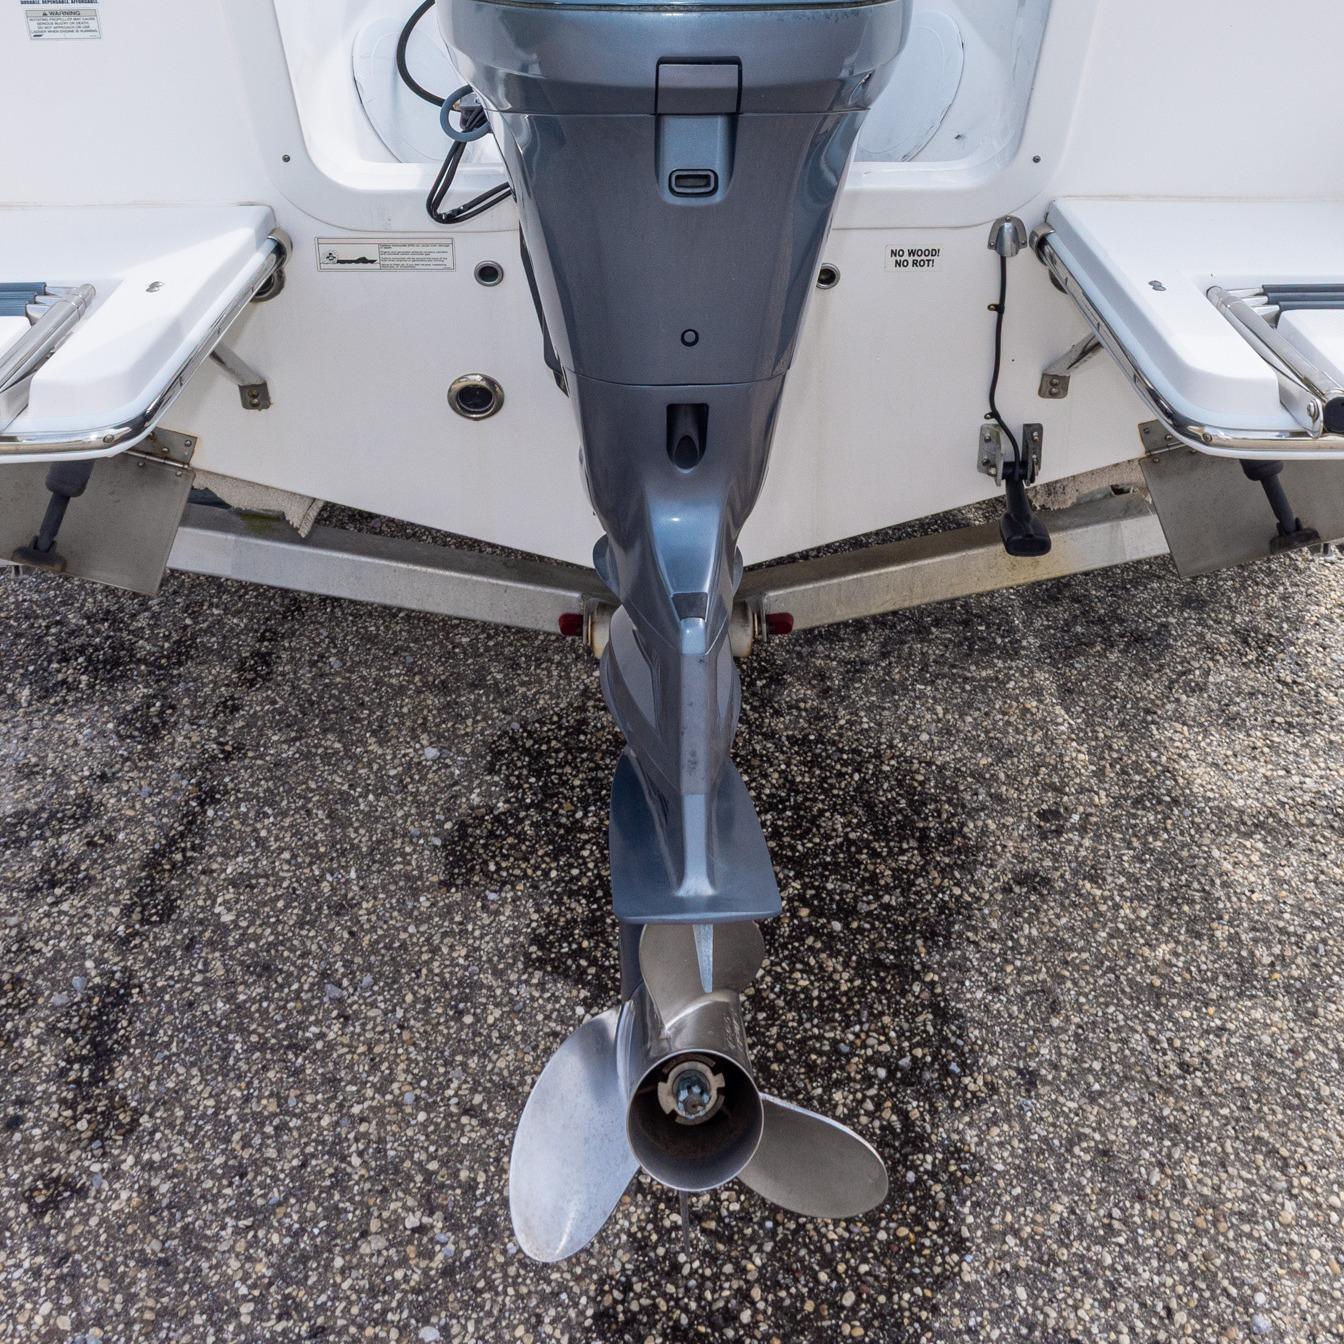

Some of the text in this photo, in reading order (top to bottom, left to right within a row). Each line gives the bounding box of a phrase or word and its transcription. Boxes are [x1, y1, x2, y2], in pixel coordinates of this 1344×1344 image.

[890, 248, 940, 258] NO WOOD!
[895, 259, 934, 268] NO ROT!
